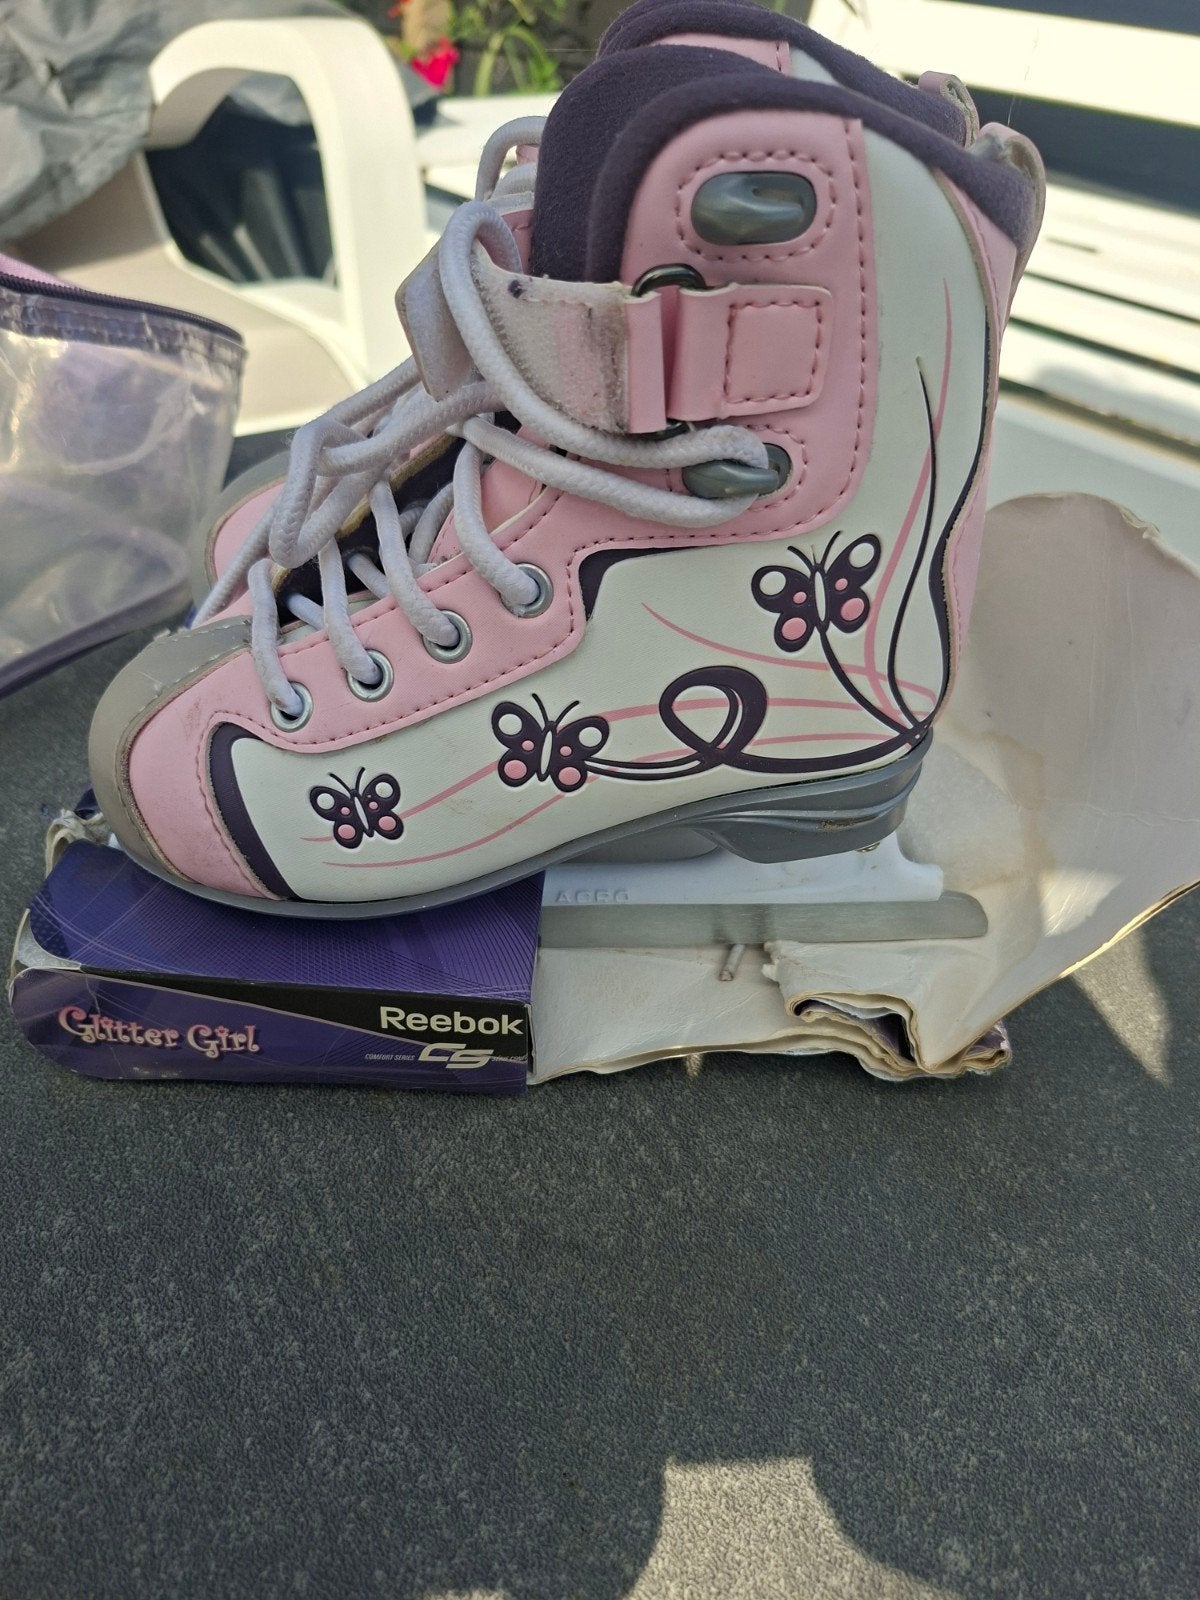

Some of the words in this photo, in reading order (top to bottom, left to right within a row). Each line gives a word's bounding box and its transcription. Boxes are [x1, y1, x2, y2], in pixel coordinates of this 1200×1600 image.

[58, 1005, 180, 1048] Glitter
[187, 1024, 260, 1058] Girl
[379, 1005, 525, 1036] Reebok
[364, 1053, 394, 1061] COMFORT
